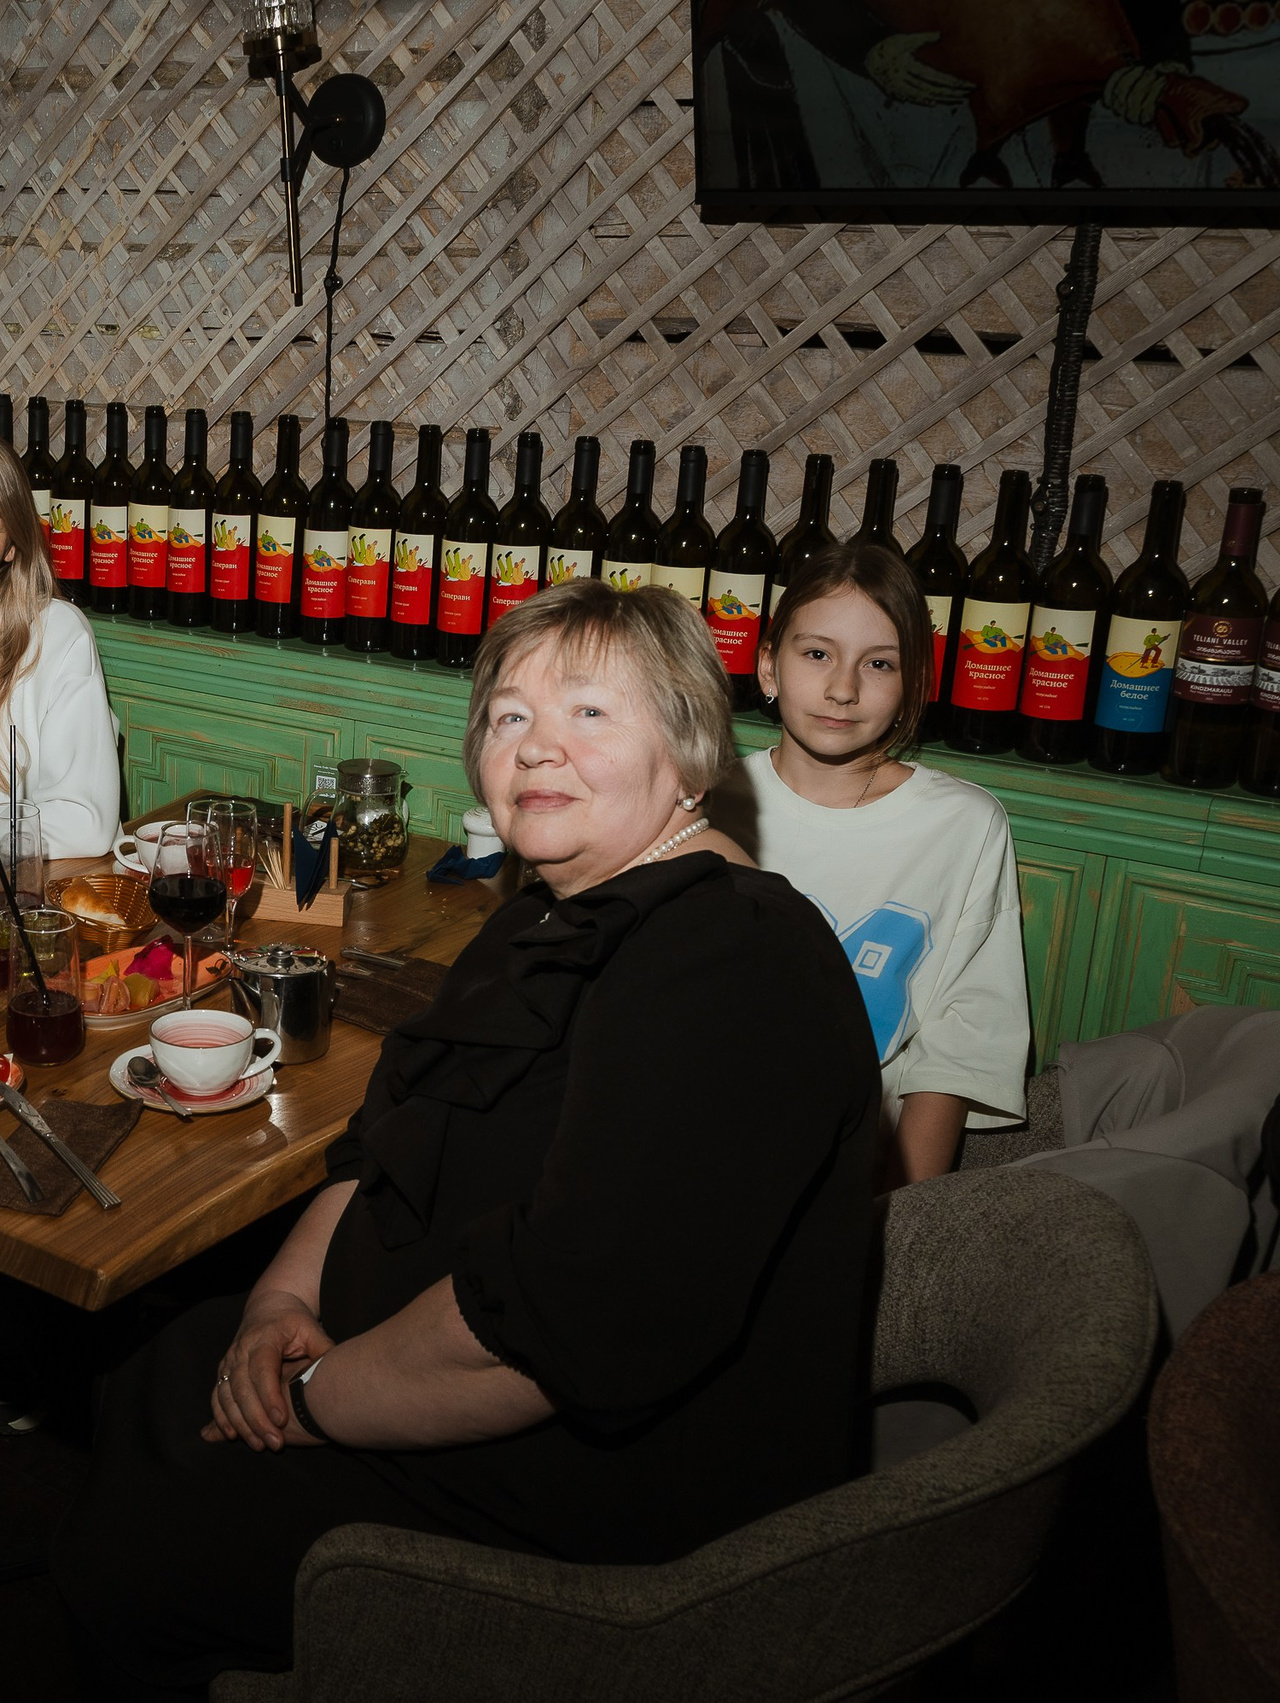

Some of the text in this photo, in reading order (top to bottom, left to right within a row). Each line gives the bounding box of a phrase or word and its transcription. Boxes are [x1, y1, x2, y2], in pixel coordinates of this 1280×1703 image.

[305, 577, 338, 587] Домашнее
[307, 586, 334, 594] красное
[441, 590, 471, 601] Саперави
[713, 636, 743, 645] расное
[1193, 634, 1220, 644] TELIANI
[964, 660, 1012, 672] Домашнее
[968, 670, 1006, 680] красное
[1029, 667, 1075, 680] Домашнее
[1032, 678, 1068, 688] красное
[1110, 679, 1160, 692] Домашнее
[1120, 690, 1149, 700] белое
